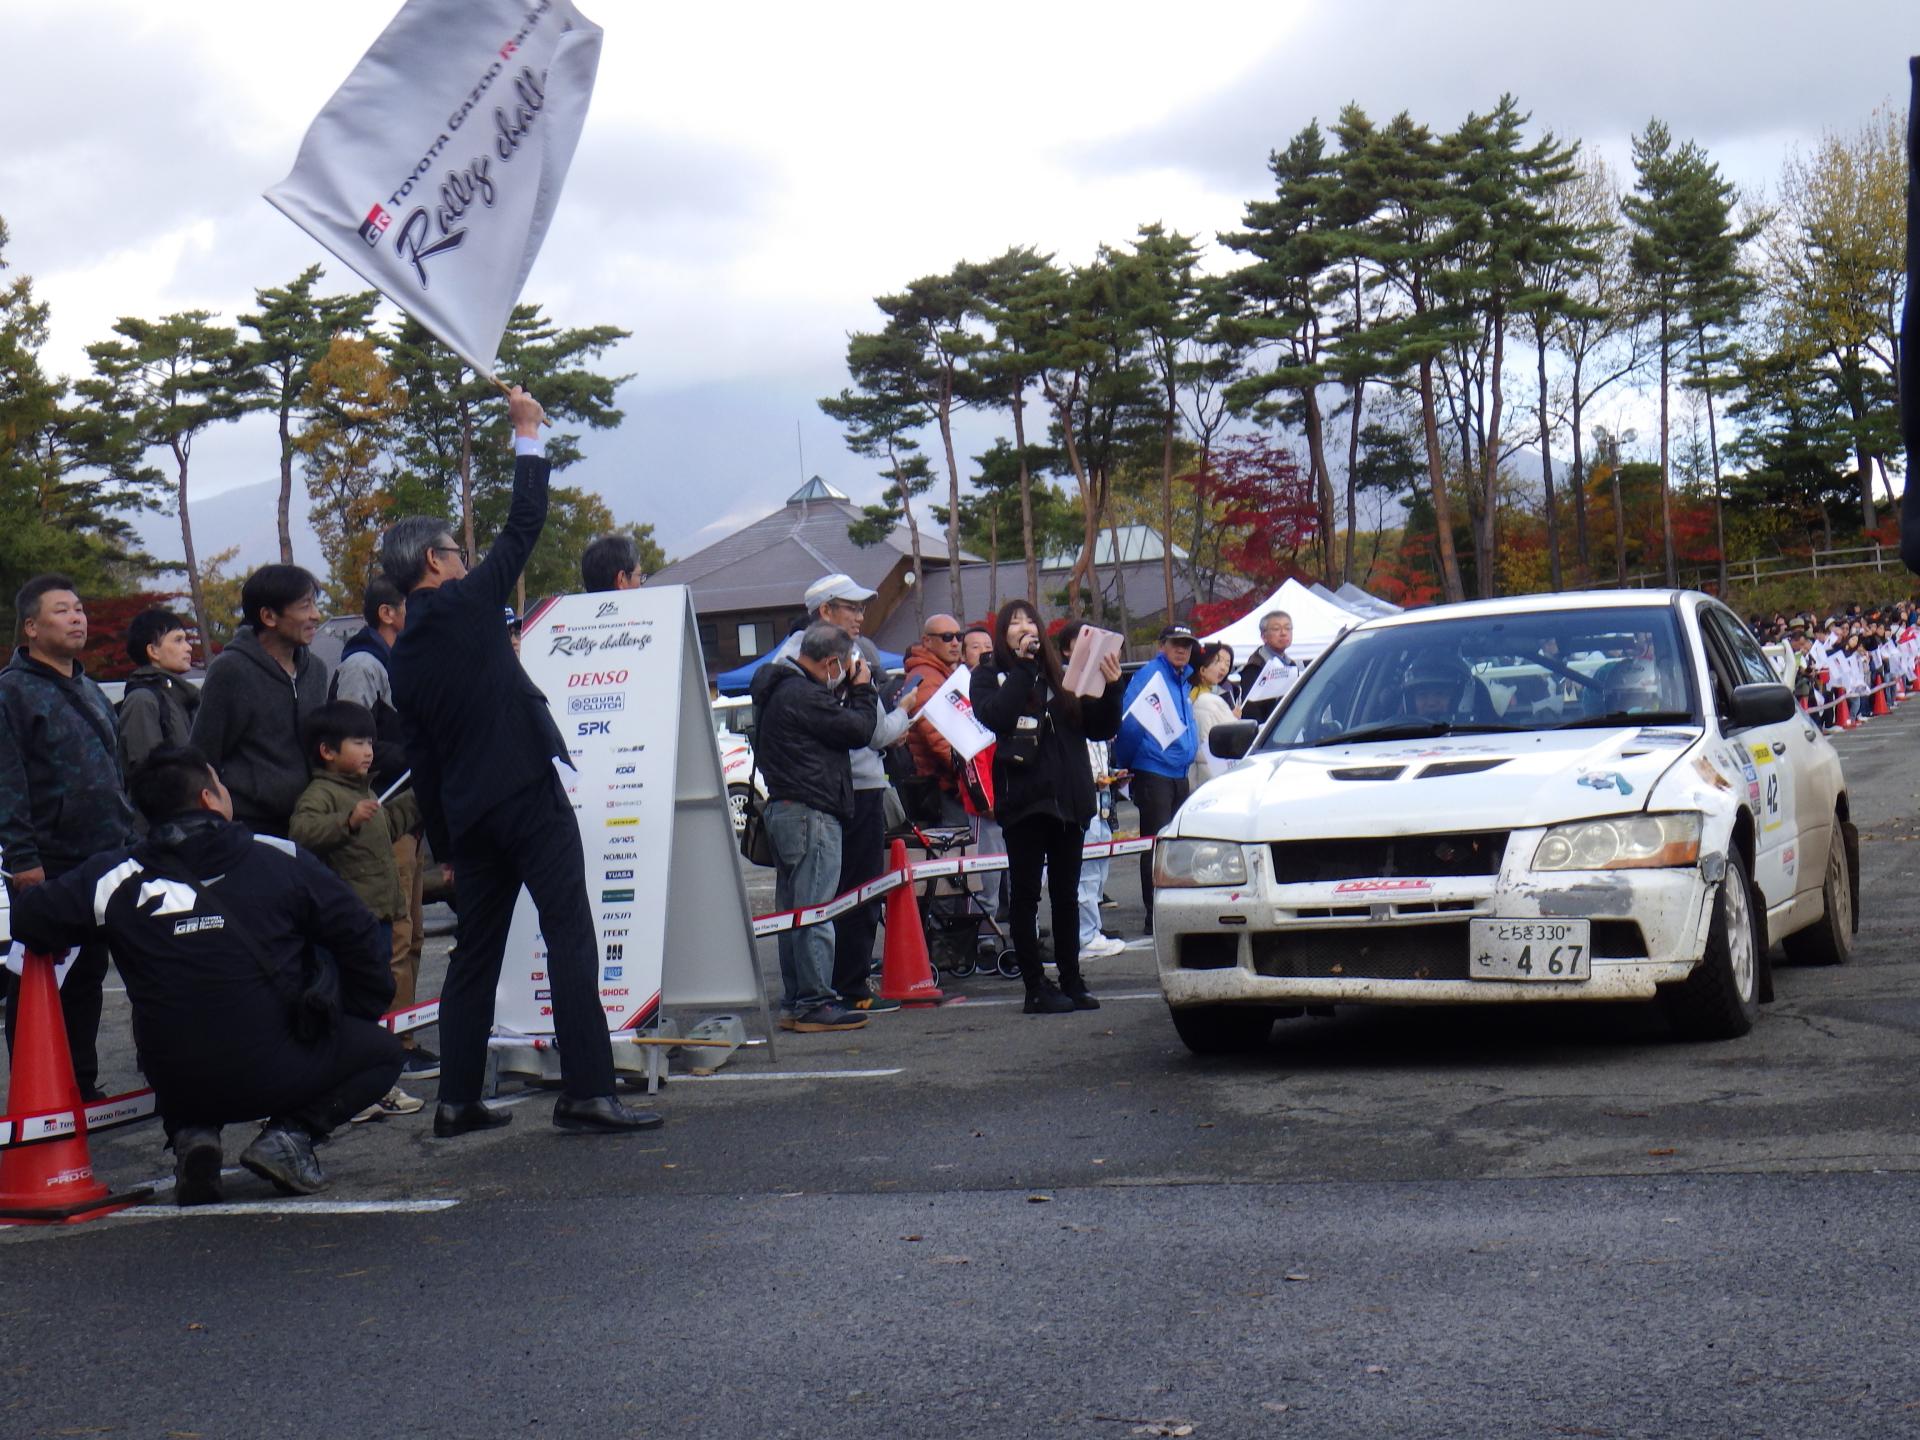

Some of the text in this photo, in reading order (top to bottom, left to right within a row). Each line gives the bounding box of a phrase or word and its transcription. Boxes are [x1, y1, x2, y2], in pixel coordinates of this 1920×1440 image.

[358, 203, 393, 248] GR
[388, 133, 450, 206] TOYOTA
[447, 62, 502, 131] GAZOO
[395, 66, 548, 290] Rally chall
[548, 631, 652, 656] Rally challenge
[568, 670, 628, 688] DENSO
[583, 702, 621, 711] CLUTCH
[578, 721, 611, 736] SPK
[615, 766, 636, 774] KDDI
[1766, 773, 1778, 814] 42
[603, 852, 638, 861] NOMURA
[608, 871, 632, 879] YUASA
[603, 912, 632, 920] AISIN
[604, 929, 629, 938] JTEKT
[1498, 925, 1565, 940] とちぎ330
[1478, 952, 1493, 966] せ
[598, 988, 629, 996] -SHOCK
[602, 1005, 625, 1013] RD
